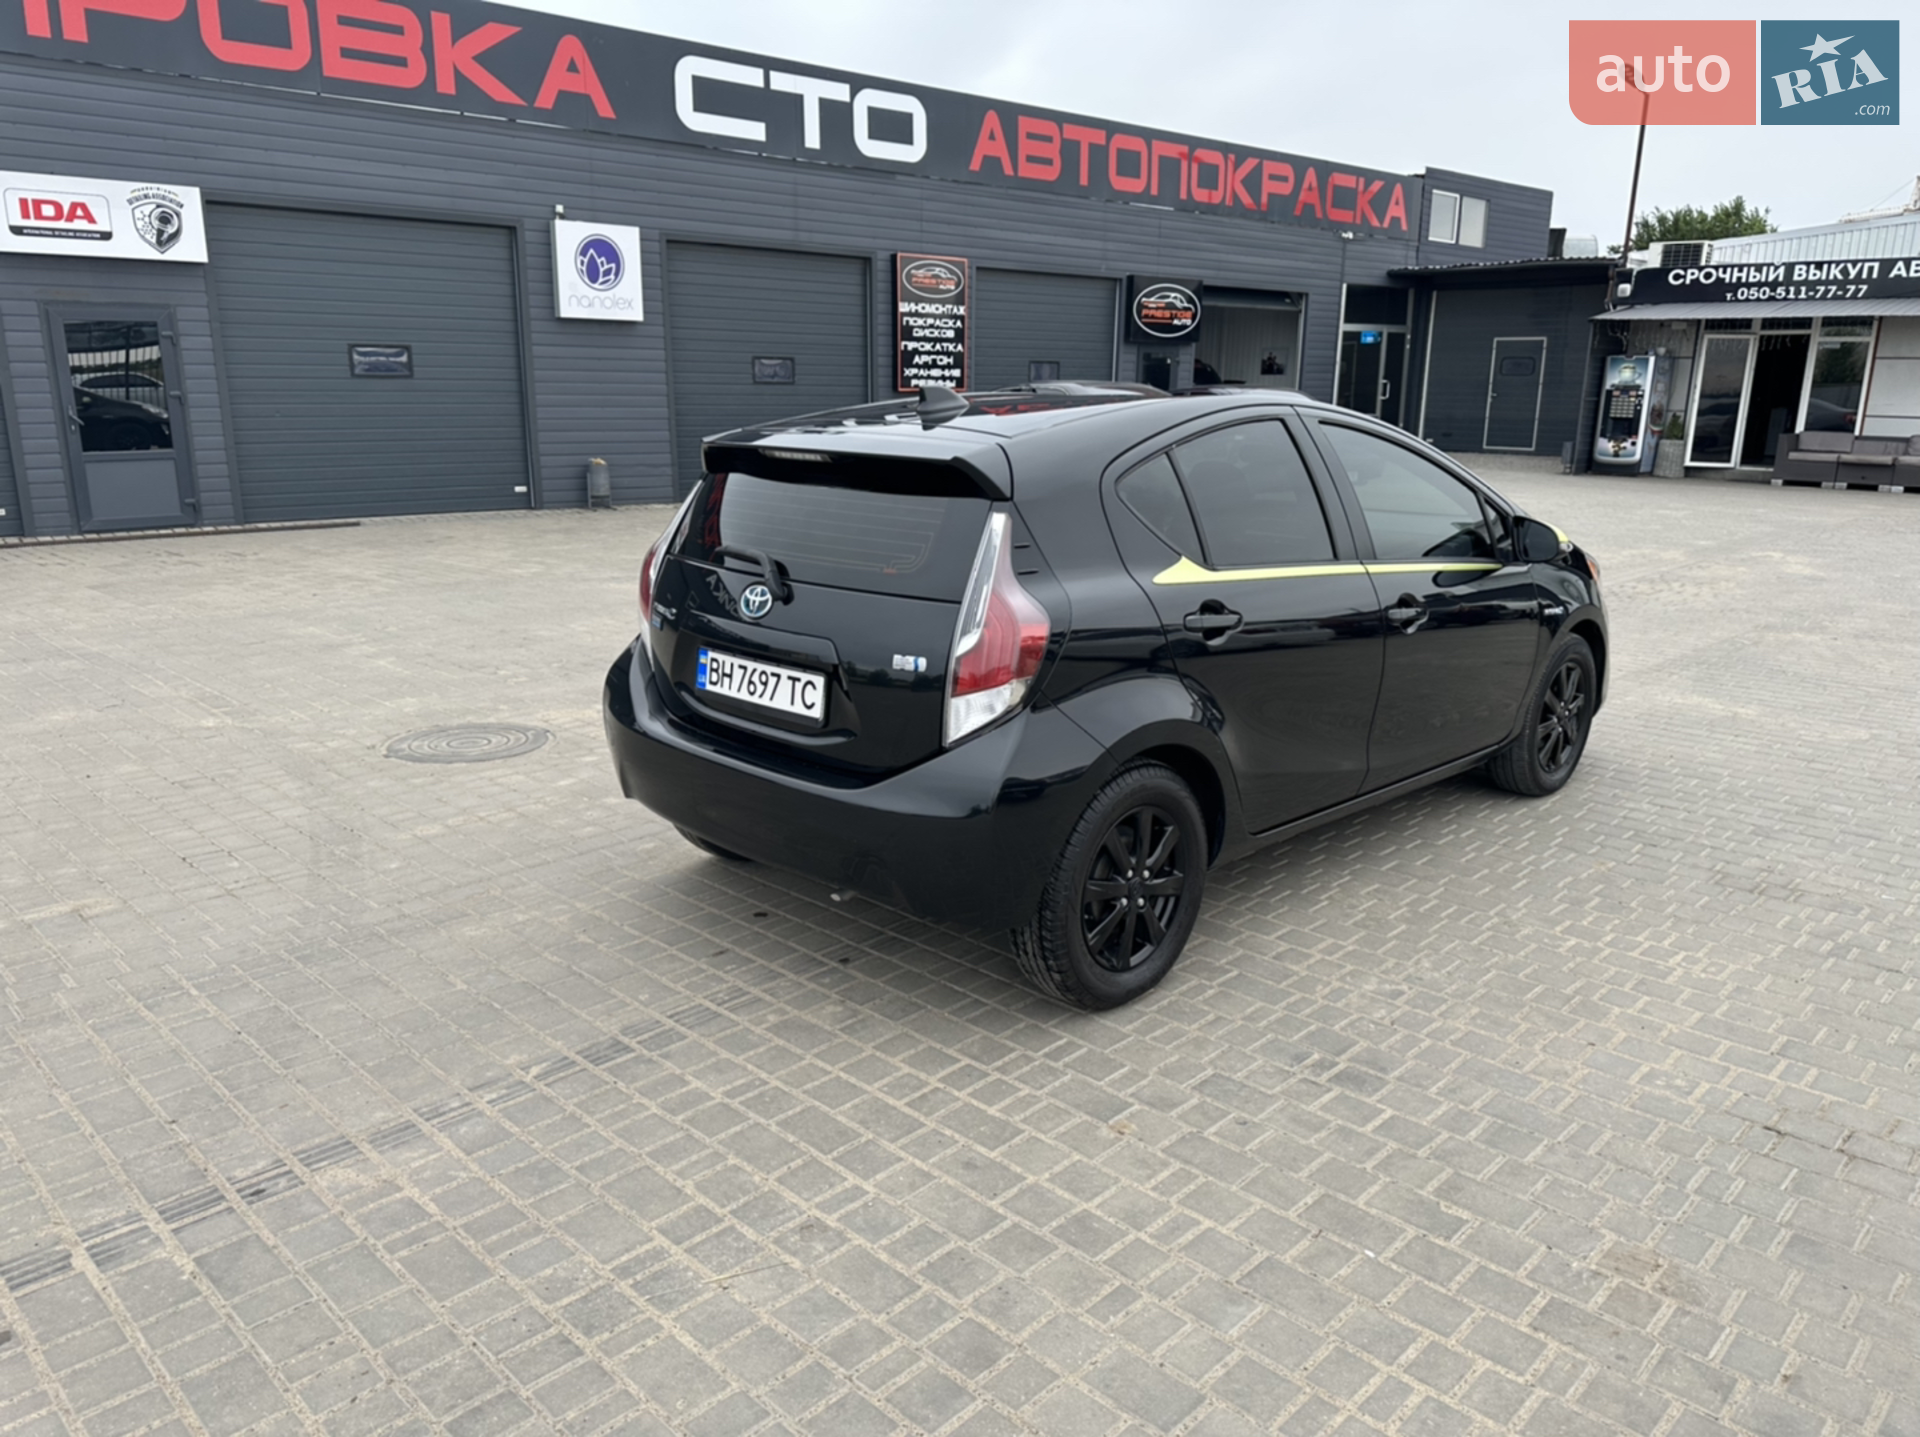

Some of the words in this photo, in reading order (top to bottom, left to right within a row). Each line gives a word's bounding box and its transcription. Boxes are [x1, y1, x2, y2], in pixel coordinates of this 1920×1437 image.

[22, 0, 616, 119] ОВКА
[674, 54, 928, 163] СТО
[968, 109, 1409, 232] АВТОПОКРАСКА
[18, 197, 98, 225] IDA
[1667, 264, 1786, 285] СРОЧНЫЙ
[1793, 261, 1880, 281] ВЫКУП
[568, 292, 635, 310] nanolex
[903, 316, 963, 329] ПОКРАСКА
[1141, 308, 1193, 319] PRESTIGE
[900, 341, 964, 353] ПРОКАТКА
[912, 354, 954, 366] АРГОН
[708, 657, 735, 691] BH
[736, 664, 782, 702] 7697
[787, 675, 817, 710] TC
